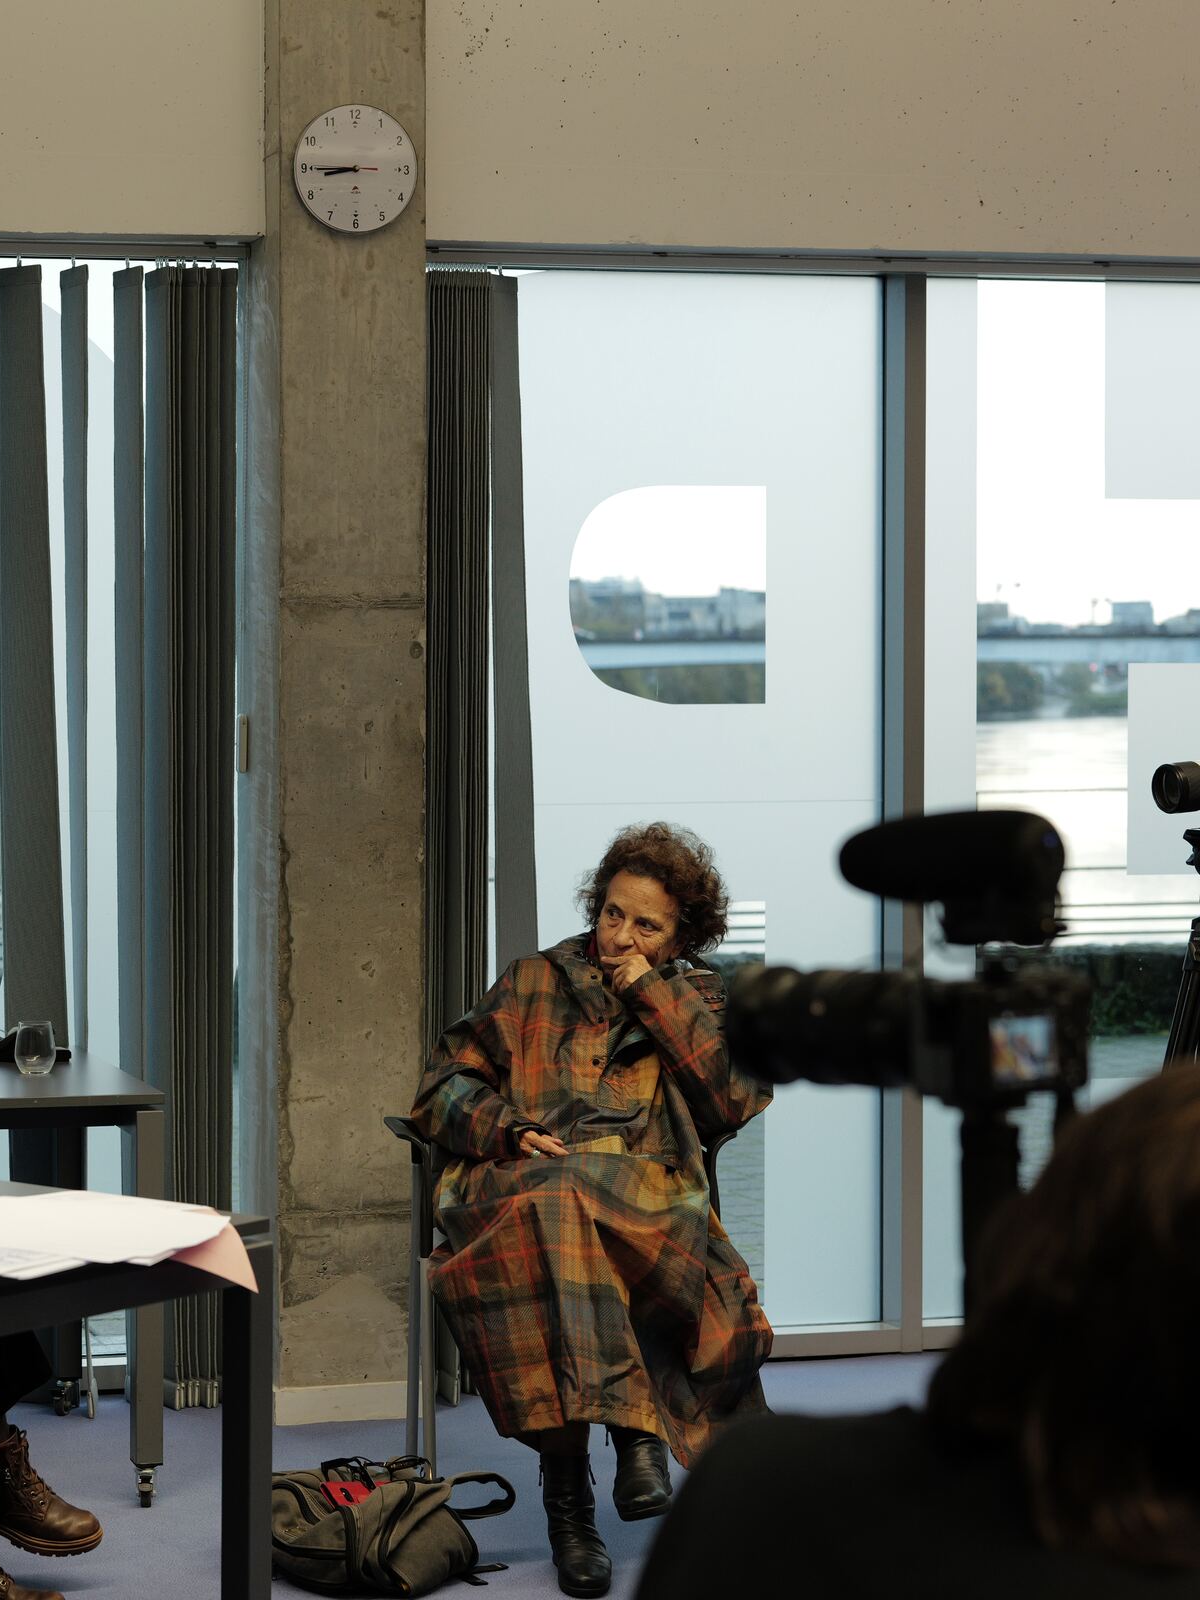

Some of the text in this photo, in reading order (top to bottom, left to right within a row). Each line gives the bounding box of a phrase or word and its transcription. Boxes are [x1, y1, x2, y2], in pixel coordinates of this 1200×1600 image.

[350, 109, 361, 120] 12
[324, 116, 335, 127] 11
[378, 118, 383, 128] 1
[305, 136, 316, 146] 10
[396, 135, 403, 146] 2
[301, 163, 307, 173] 9
[403, 165, 410, 175] 3
[307, 190, 314, 200] 8
[397, 192, 404, 202] 4
[327, 210, 334, 221] 7
[379, 211, 385, 221] 5
[352, 218, 359, 229] 6
